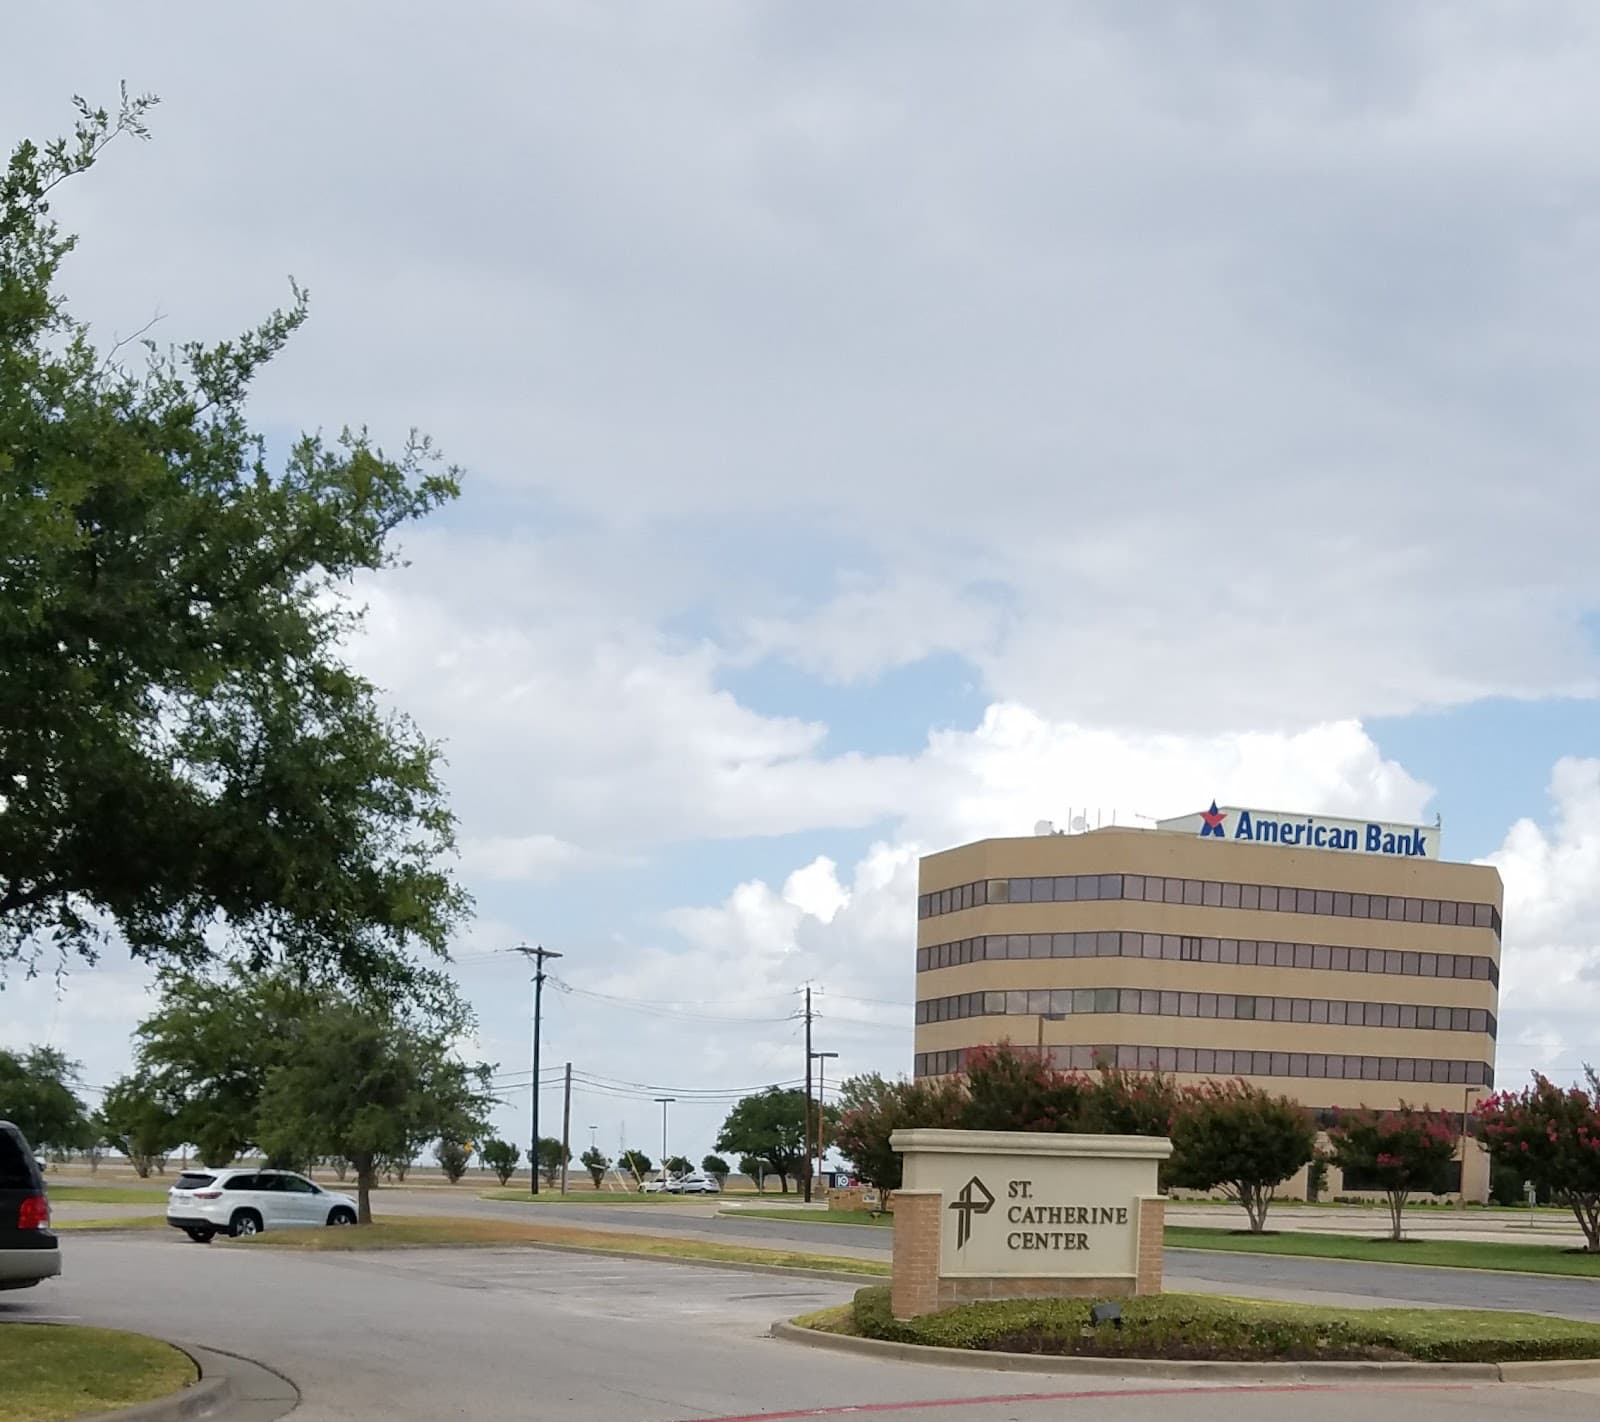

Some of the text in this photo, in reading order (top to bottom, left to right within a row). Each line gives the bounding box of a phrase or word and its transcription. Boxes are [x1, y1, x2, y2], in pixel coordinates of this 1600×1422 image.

[1235, 811, 1426, 856] American Bank
[1008, 1181, 1033, 1198] ST.
[1008, 1206, 1128, 1224] CATHERINE
[1008, 1232, 1090, 1250] CENTER
